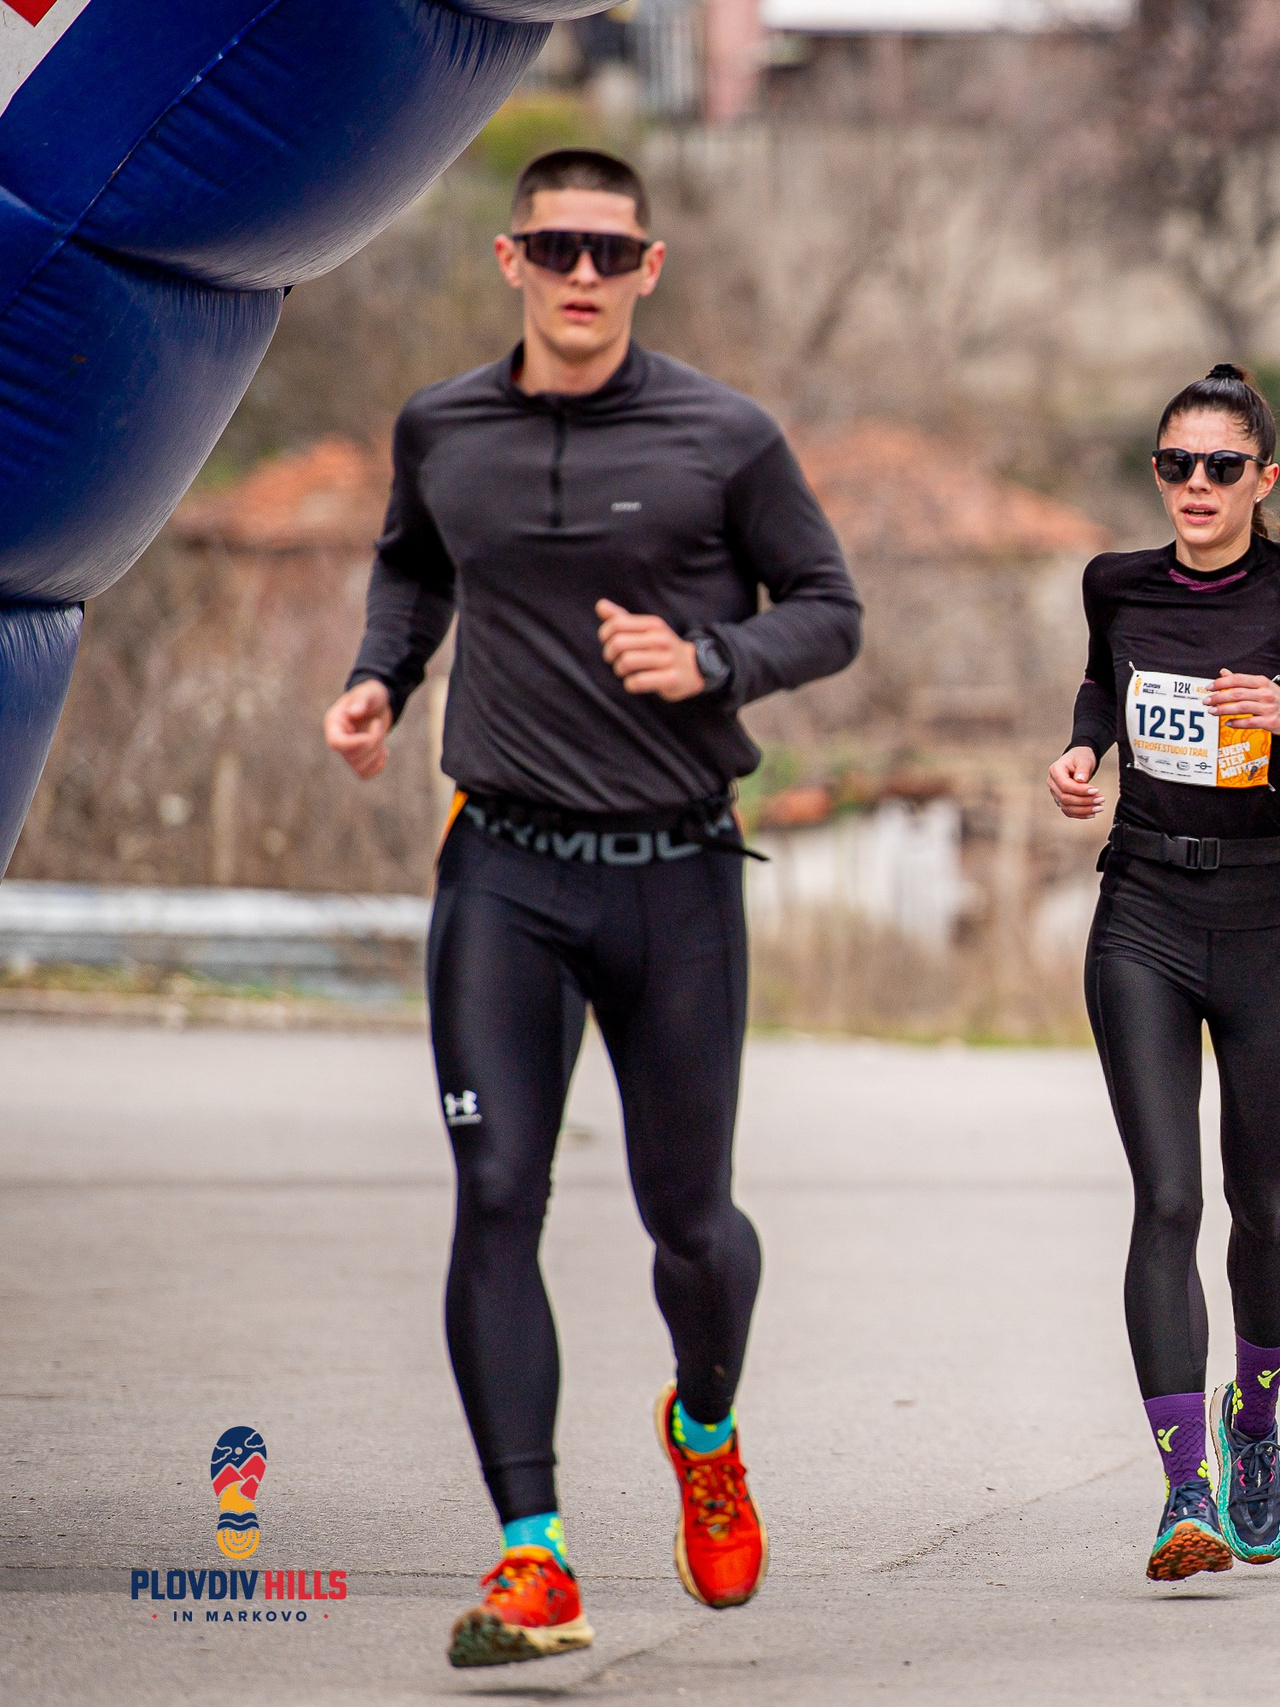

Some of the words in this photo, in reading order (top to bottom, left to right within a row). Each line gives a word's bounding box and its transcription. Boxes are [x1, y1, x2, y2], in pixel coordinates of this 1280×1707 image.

[1173, 681, 1191, 694] 12K
[1135, 703, 1205, 743] 1255
[1189, 747, 1208, 758] TRAIL
[1218, 753, 1245, 769] STEP
